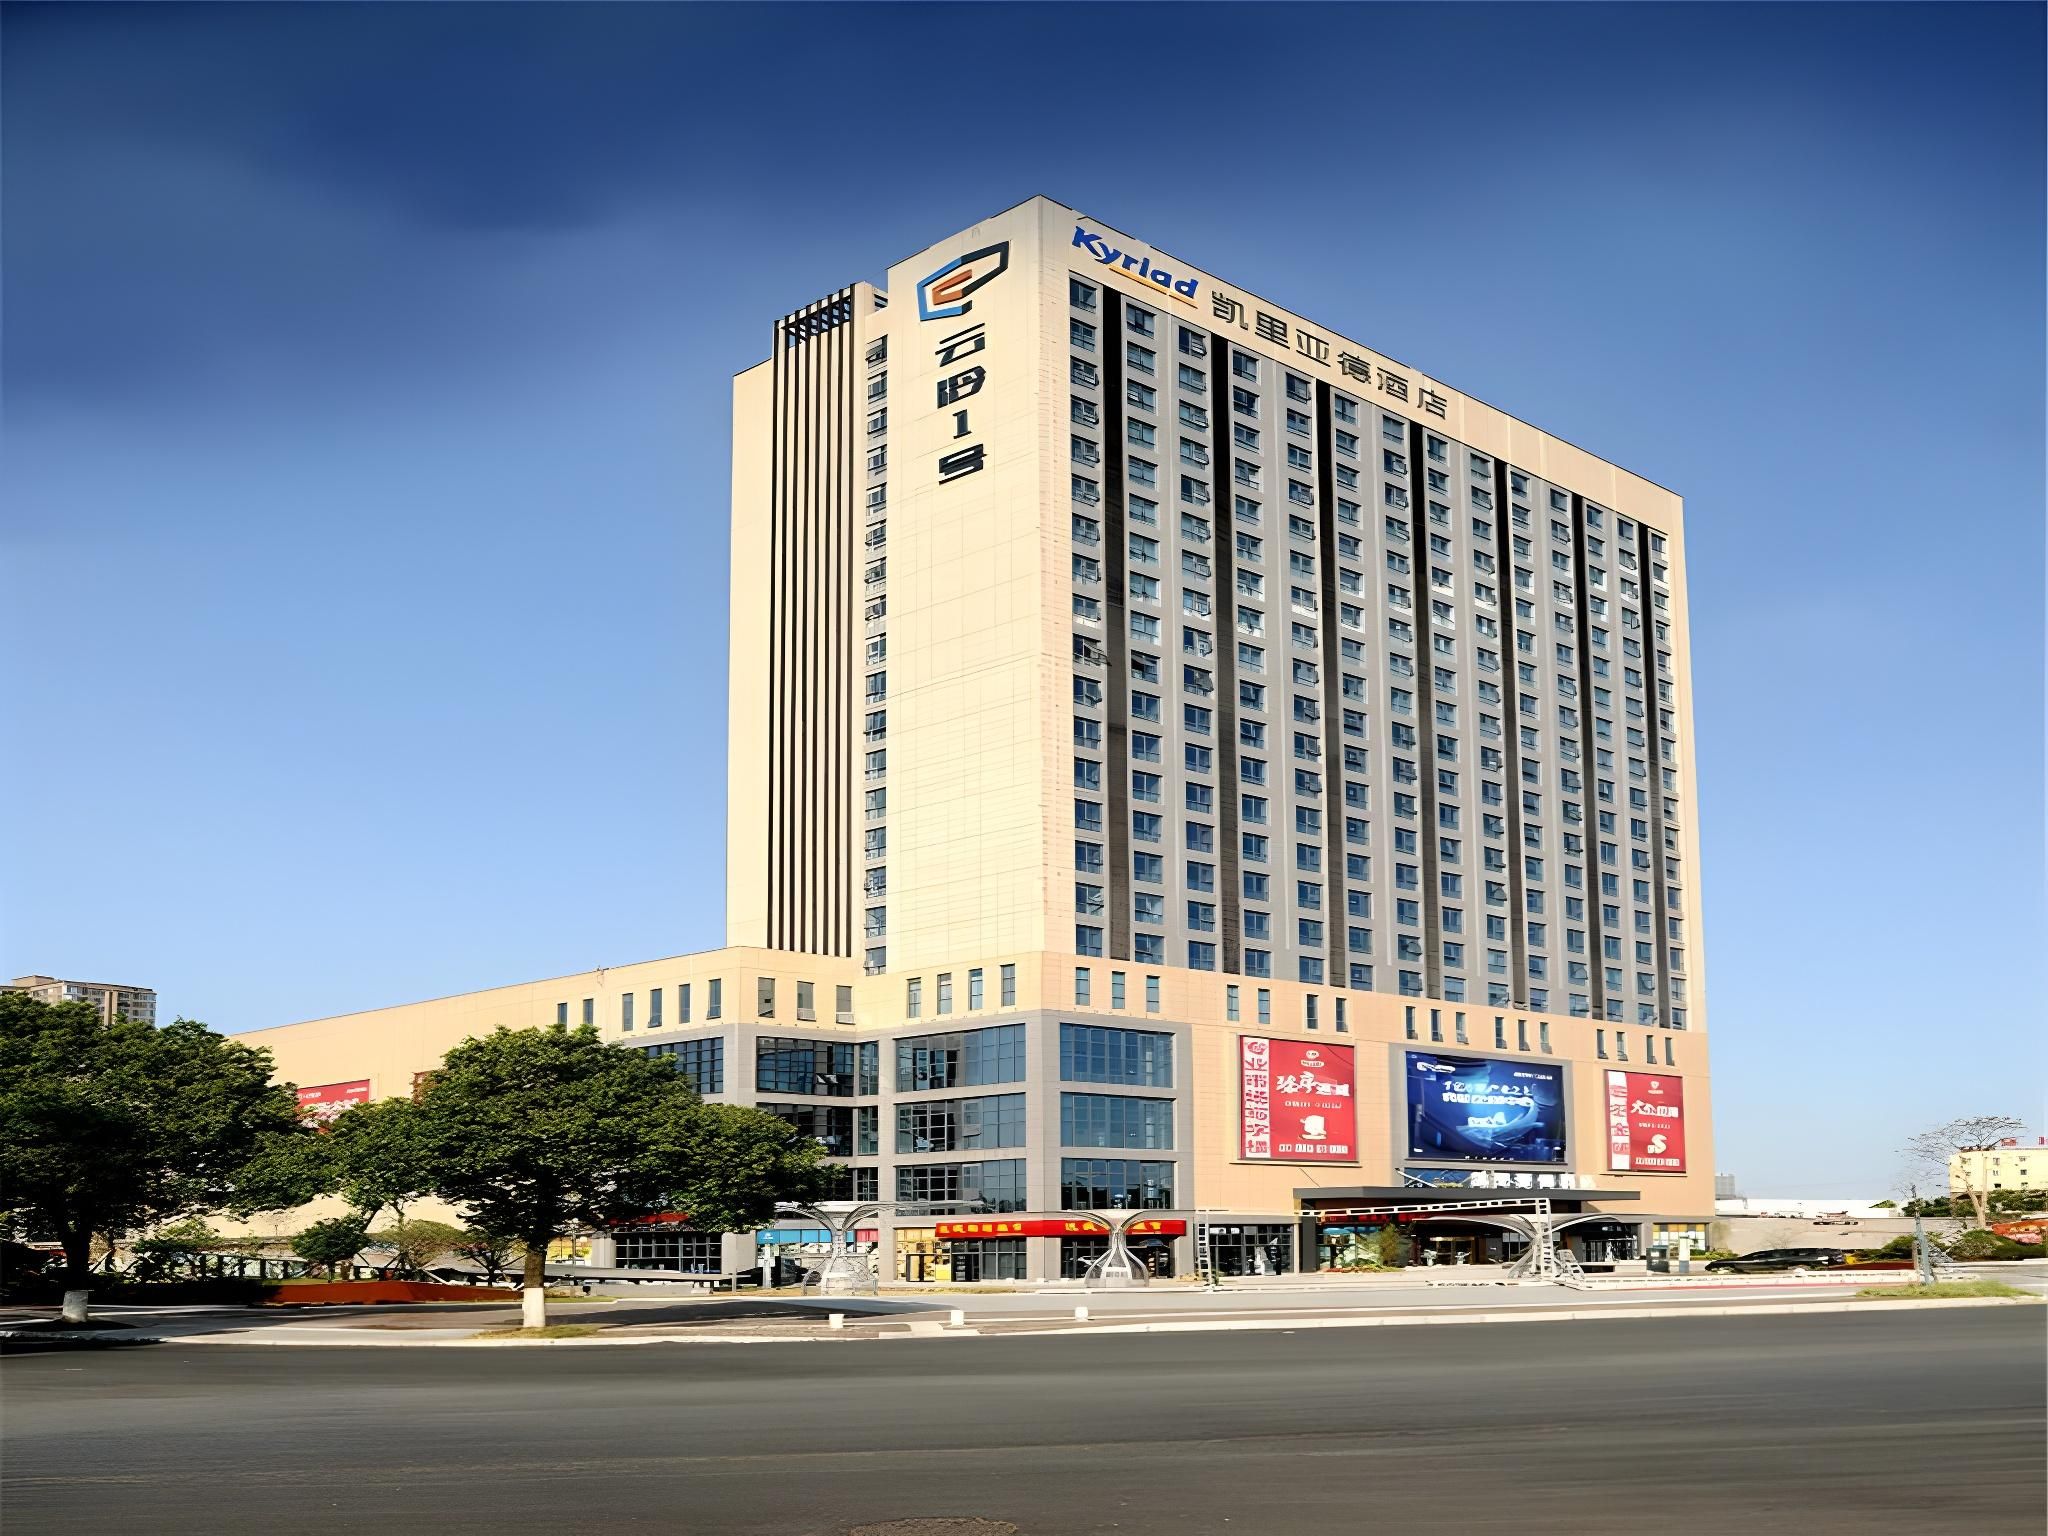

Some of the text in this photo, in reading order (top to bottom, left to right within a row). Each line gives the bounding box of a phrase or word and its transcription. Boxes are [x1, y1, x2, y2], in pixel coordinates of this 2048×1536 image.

[1072, 226, 1198, 299] Kyriad
[1212, 291, 1447, 420] 凯里亚德酒店
